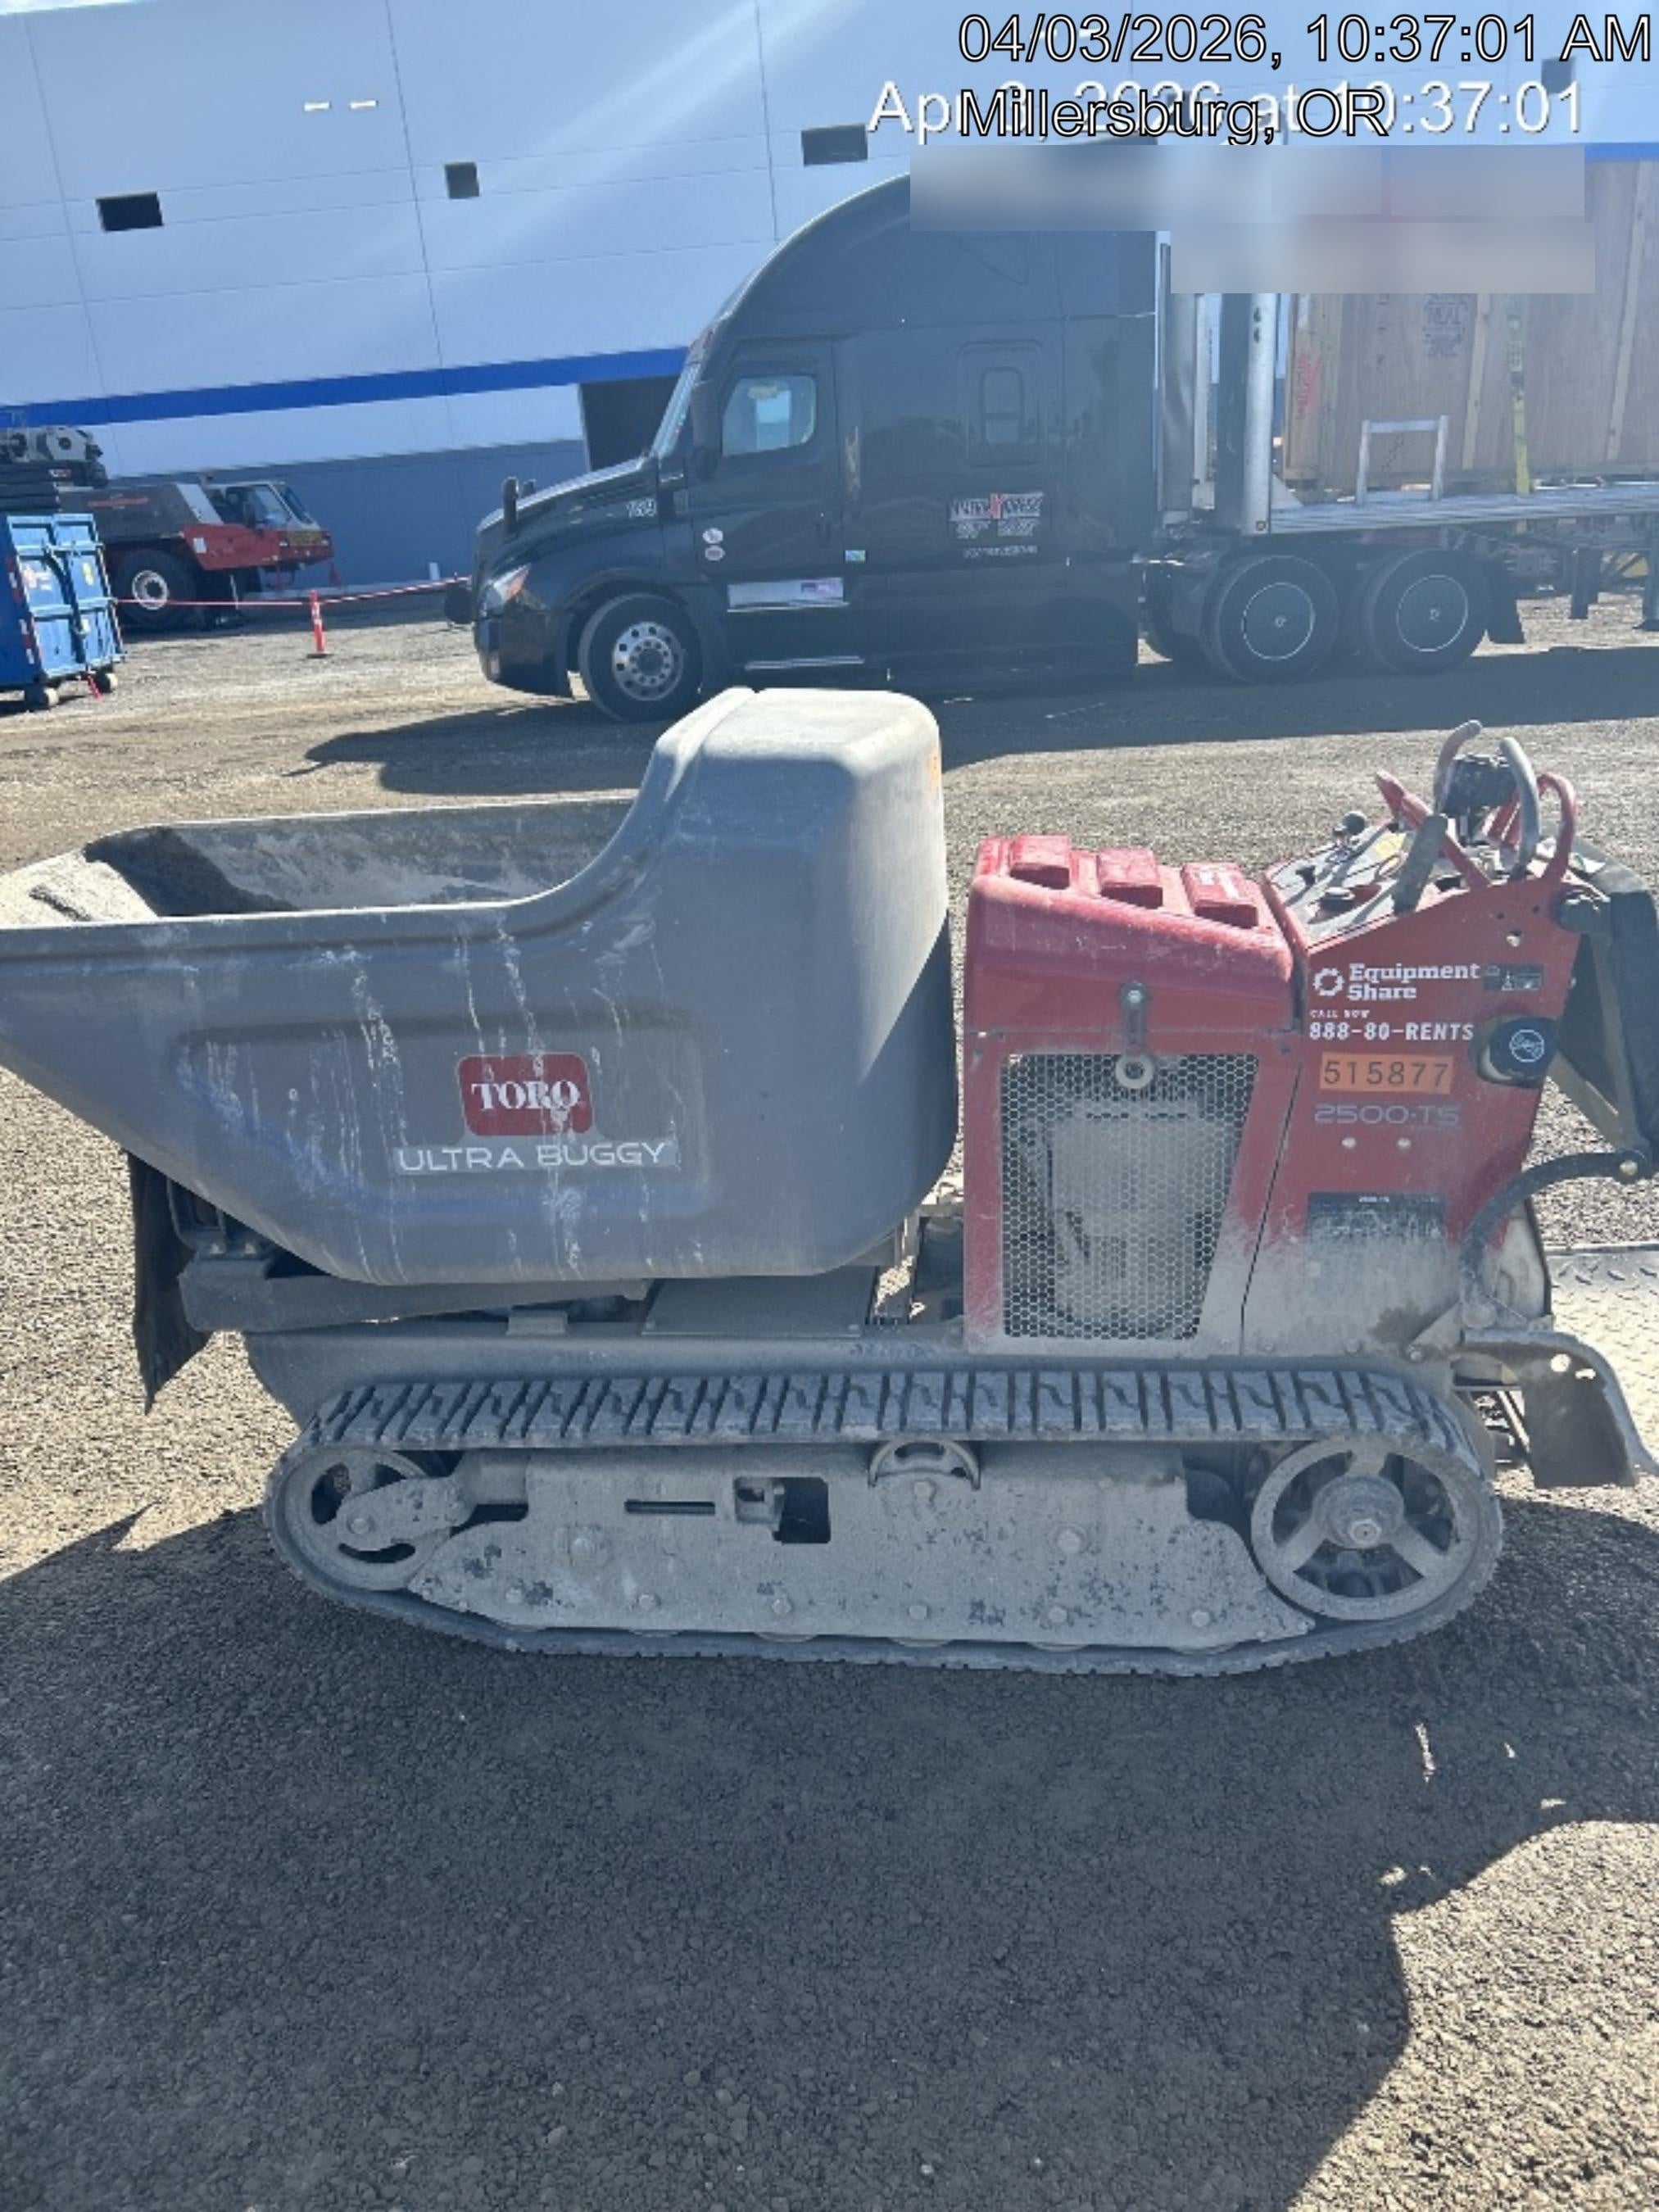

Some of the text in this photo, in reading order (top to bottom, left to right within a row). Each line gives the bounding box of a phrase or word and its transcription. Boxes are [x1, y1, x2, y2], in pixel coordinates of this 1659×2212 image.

[1349, 962, 1481, 984] Equipment
[1347, 983, 1417, 1001] Share
[1310, 1009, 1371, 1018] CALL NOW
[1308, 1022, 1475, 1041] 888-80-RENTS
[1323, 1060, 1450, 1088] 515877
[470, 1080, 581, 1110] TORO
[397, 1141, 669, 1172] ULTRA BUGGY
